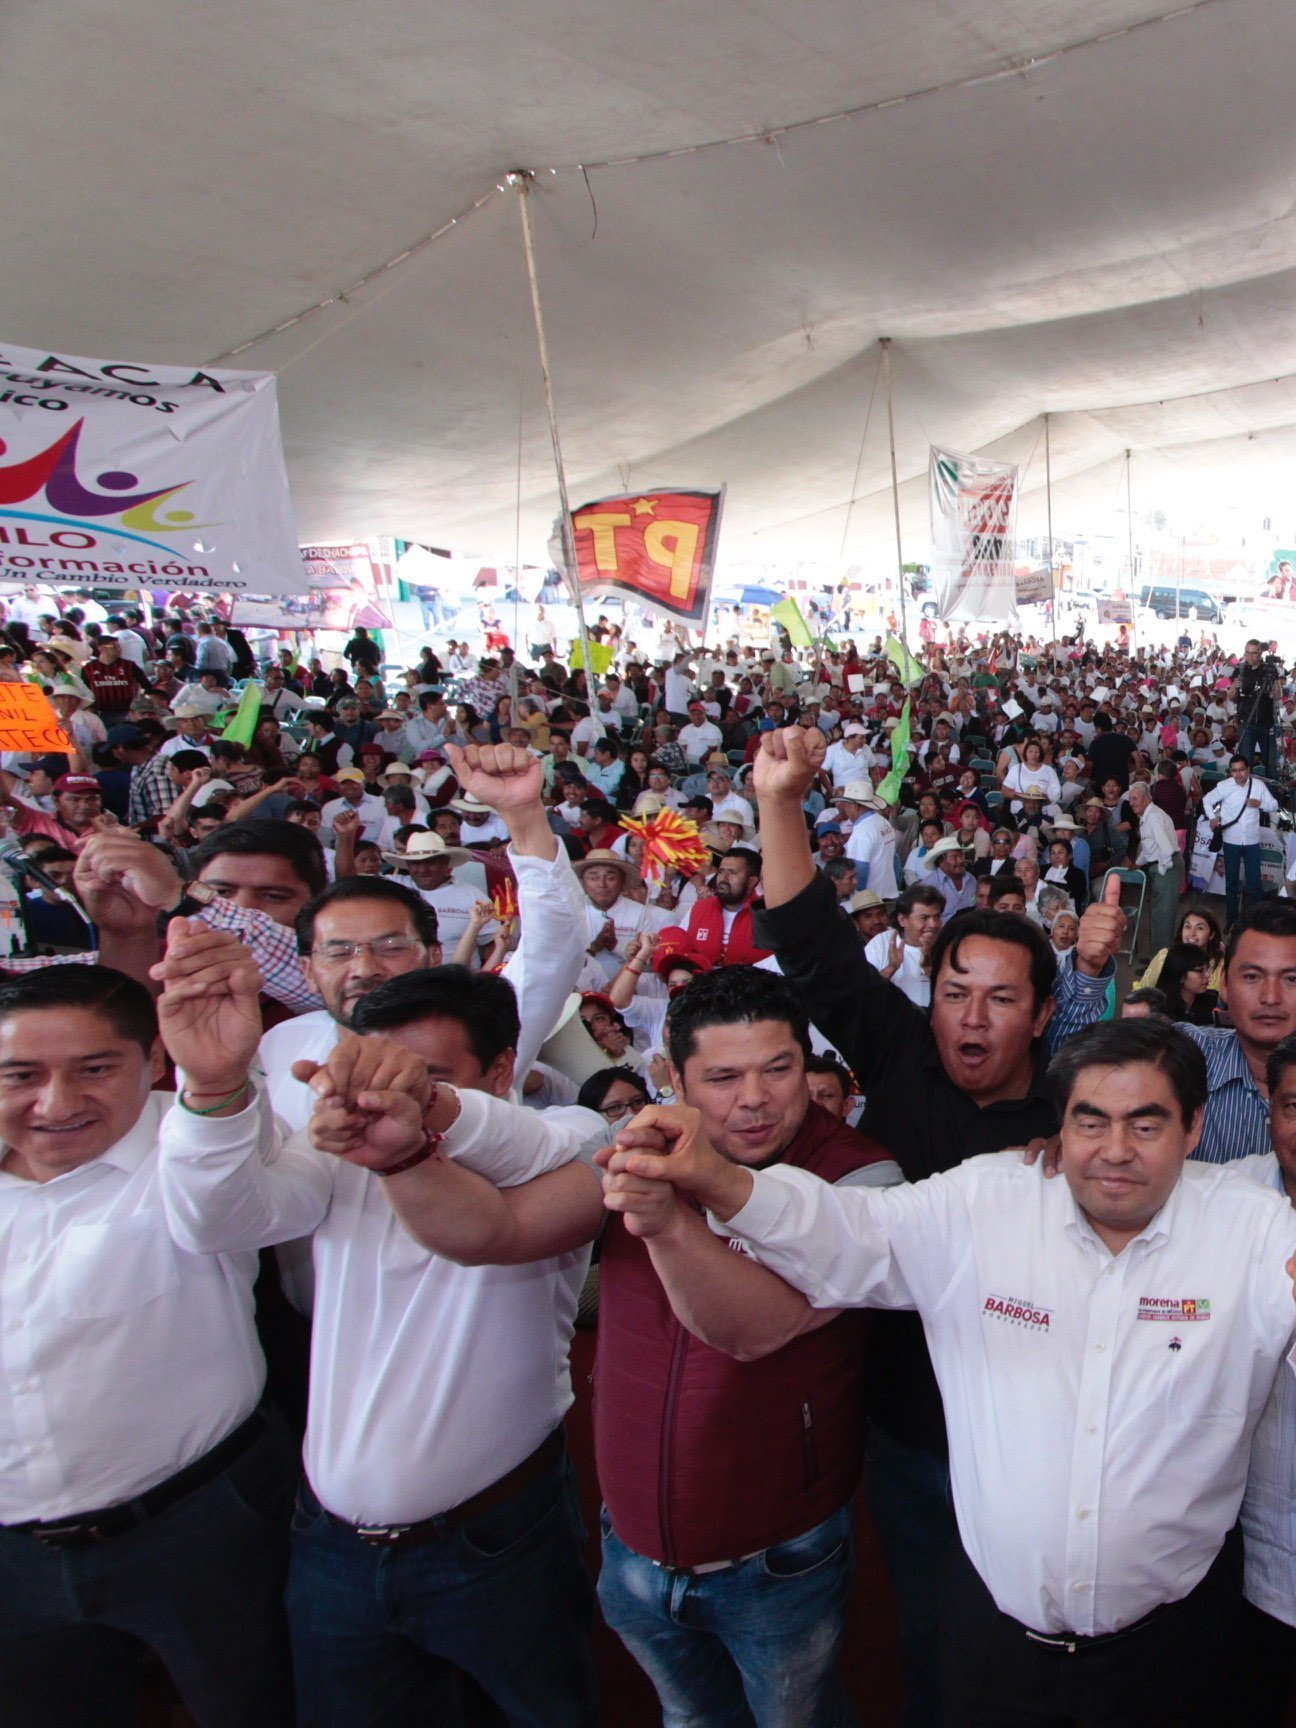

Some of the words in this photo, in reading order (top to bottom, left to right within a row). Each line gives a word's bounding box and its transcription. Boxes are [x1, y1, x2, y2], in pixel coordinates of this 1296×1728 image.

[36, 570, 129, 584] Cambio
[137, 575, 248, 588] Verdadero
[1008, 1297, 1034, 1309] MIGUEL
[1140, 1297, 1180, 1308] morena
[984, 1298, 1050, 1327] BARBOSA
